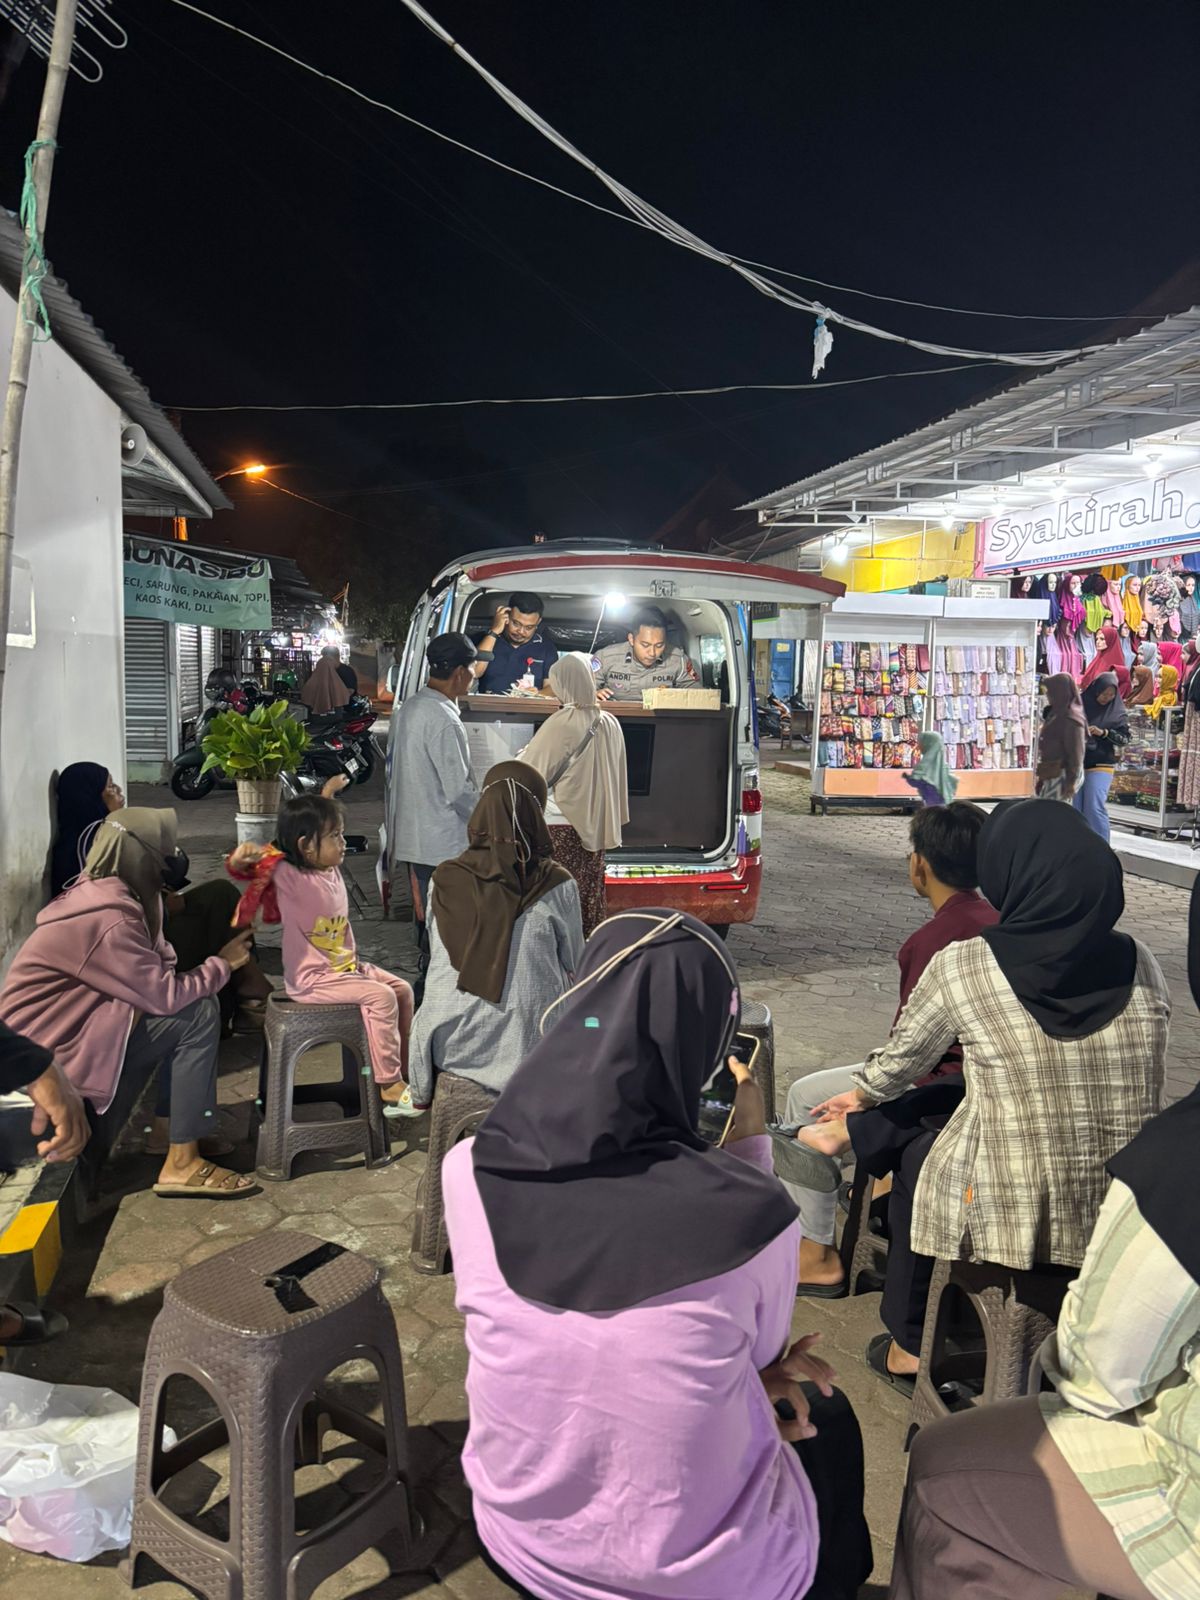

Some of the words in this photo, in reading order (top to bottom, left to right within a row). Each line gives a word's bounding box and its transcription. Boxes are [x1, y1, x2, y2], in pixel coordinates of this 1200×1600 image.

[990, 477, 1184, 562] Syakirah
[123, 576, 143, 589] ECI,
[145, 580, 190, 597] SARUNG,
[192, 588, 242, 604] PAKAIAN,
[244, 593, 270, 603] TOPI,
[135, 593, 162, 605] KAOS
[164, 597, 192, 611] KAKI,
[608, 673, 631, 681] ANDRI
